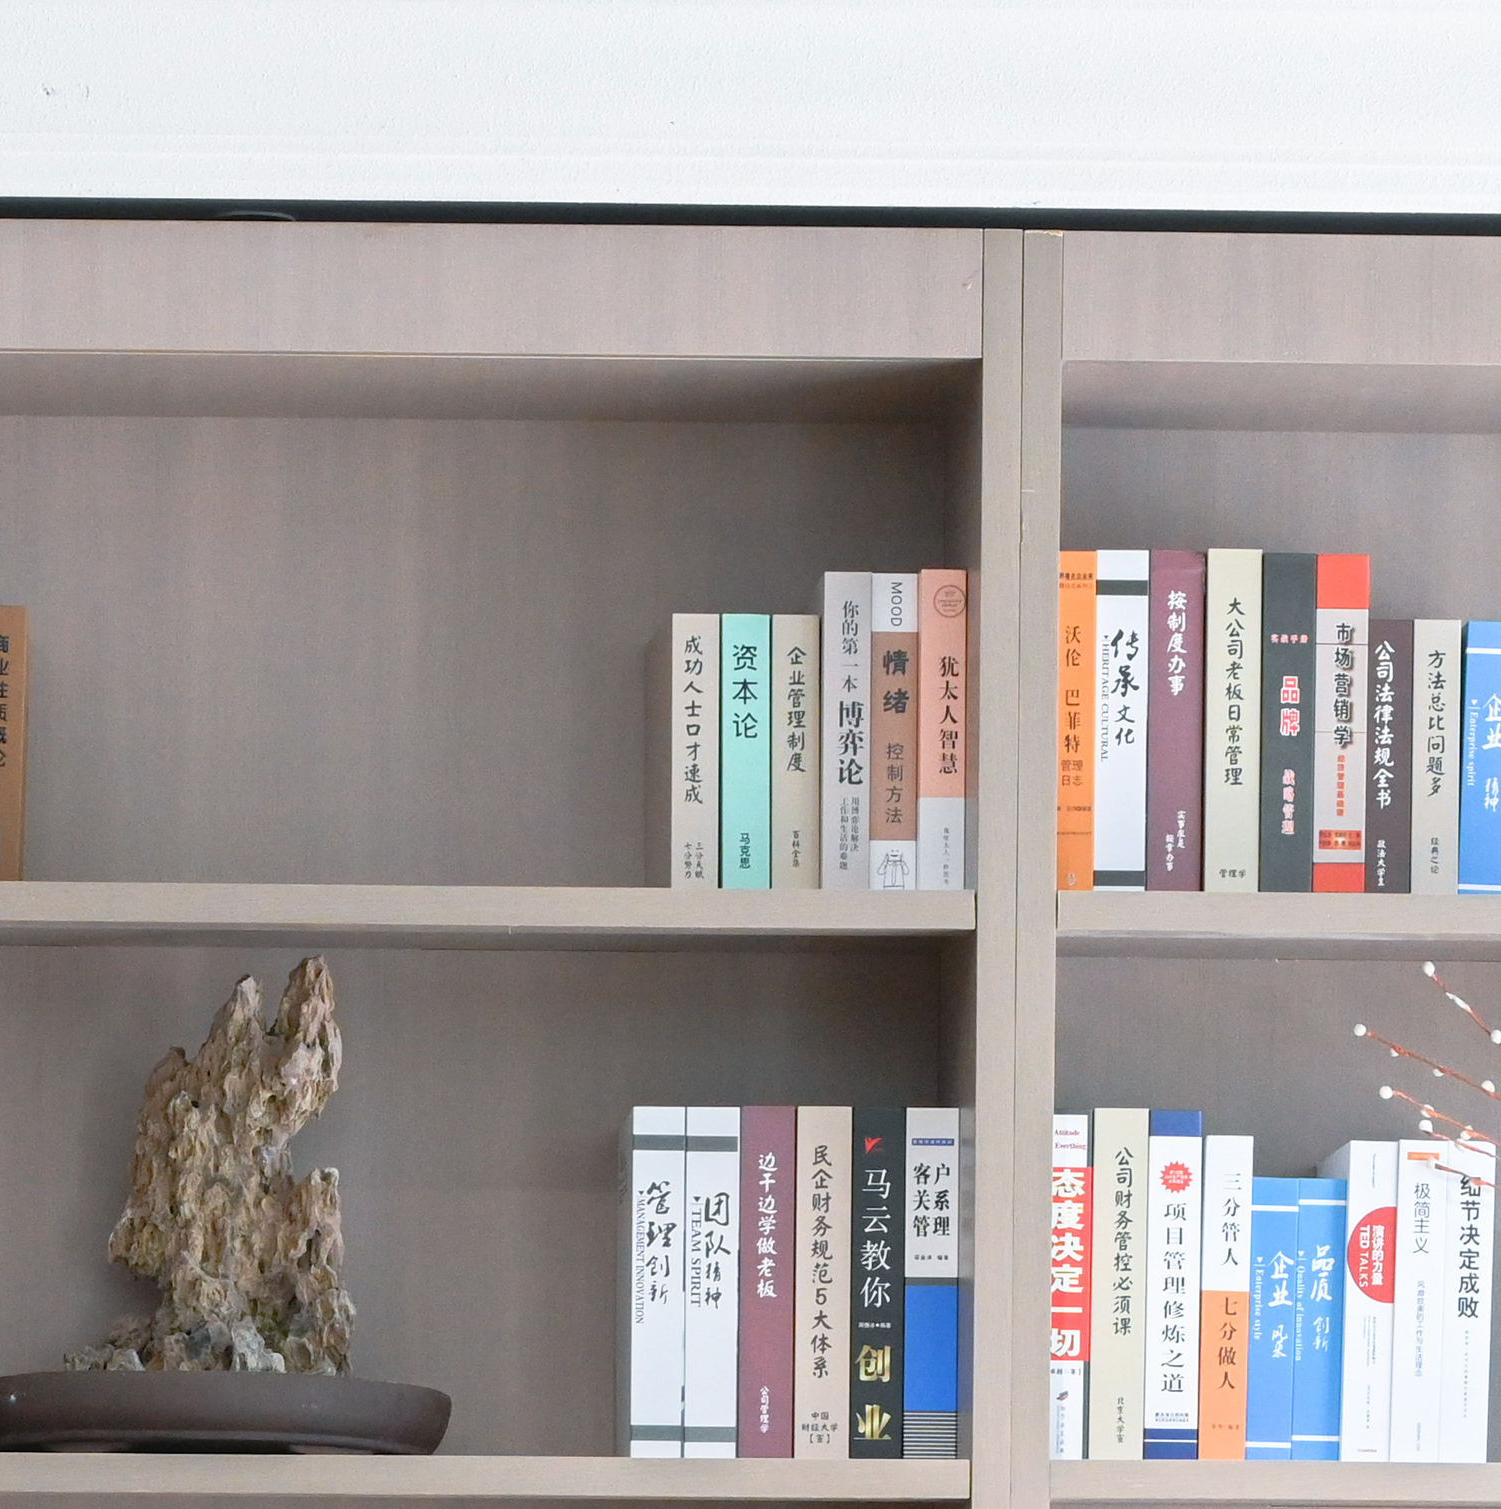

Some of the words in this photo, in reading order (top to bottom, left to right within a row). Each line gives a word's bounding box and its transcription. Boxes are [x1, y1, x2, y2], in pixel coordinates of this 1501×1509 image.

[891, 581, 903, 627] MOOD
[683, 635, 704, 805] 成功人士口才速成
[732, 644, 758, 739] 资本论
[787, 646, 807, 773] 企业管理制度
[882, 649, 909, 714] 情绪
[938, 656, 959, 775] 犹太人智慧
[1333, 622, 1354, 748] 市场营销学
[1101, 703, 1109, 762] CULTURAL
[1373, 640, 1396, 810] 公司法律法规全书
[1426, 650, 1447, 797] 方法总比问题多
[885, 742, 904, 824] 控制方法
[739, 832, 751, 869] 马克思
[791, 829, 801, 868] 百科全集
[839, 797, 849, 870] 工作和生活的难题
[1219, 869, 1246, 878] 管理学
[636, 1198, 645, 1260] MANAGEMENT
[692, 1207, 702, 1253] TEAM
[756, 1152, 779, 1299] 边干边学做老板
[860, 1168, 892, 1309] 马云教你
[1113, 1146, 1134, 1336] 公司财务管控必须课
[1221, 1172, 1242, 1266] 三分管人
[1360, 1224, 1371, 1249] TED
[1413, 1182, 1431, 1255] 极简主义
[635, 1262, 644, 1325] INNOVATION
[690, 1257, 701, 1308] SPIRIT
[810, 1145, 833, 1379] 民企财务规范5大体系
[1160, 1202, 1187, 1393] 项目管理修炼之道
[1358, 1252, 1369, 1288] TALKS
[1218, 1296, 1238, 1390] 七分做人
[759, 1385, 770, 1434] 公司管理学
[854, 1344, 892, 1440] 创业
